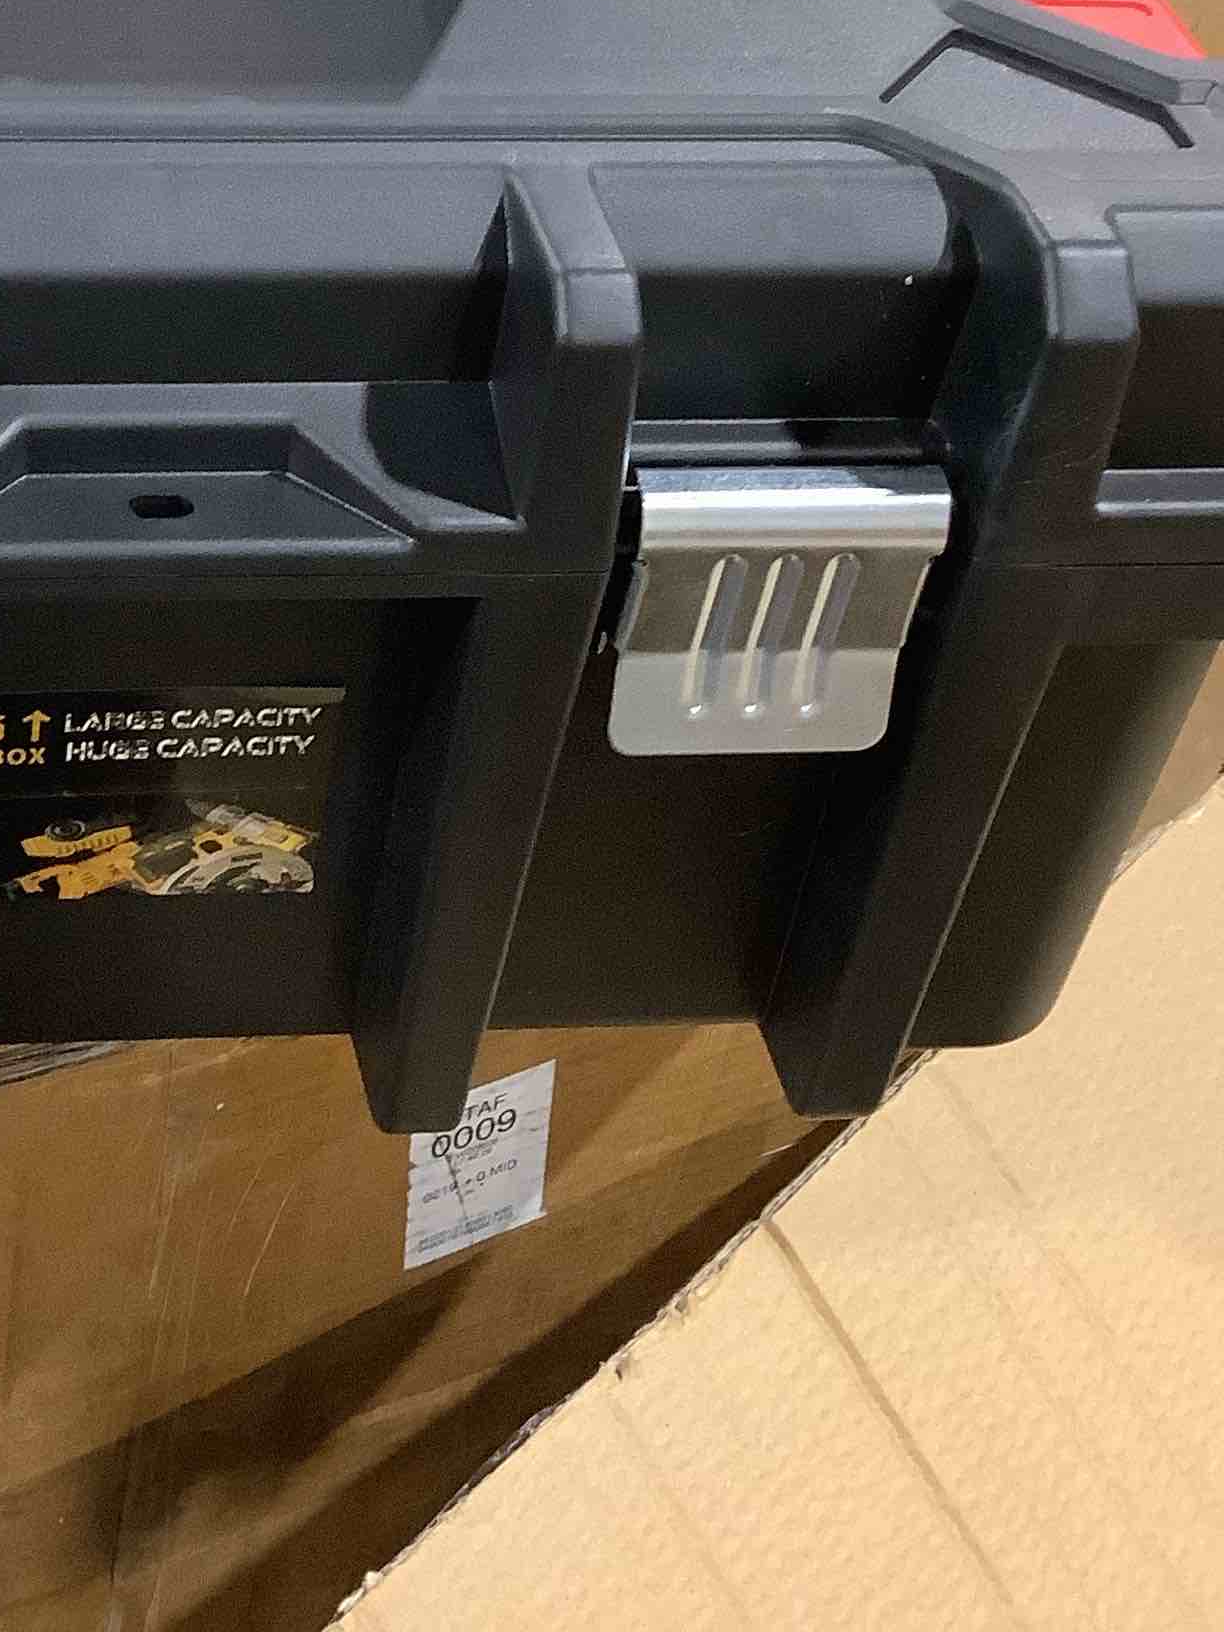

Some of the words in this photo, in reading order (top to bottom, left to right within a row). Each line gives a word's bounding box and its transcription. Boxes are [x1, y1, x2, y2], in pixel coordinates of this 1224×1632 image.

[63, 710, 166, 735] LARGE
[171, 706, 325, 730] CAPACITY
[63, 738, 151, 763] HUGE
[156, 734, 315, 759] CAPACITY
[431, 1107, 517, 1158] 0009
